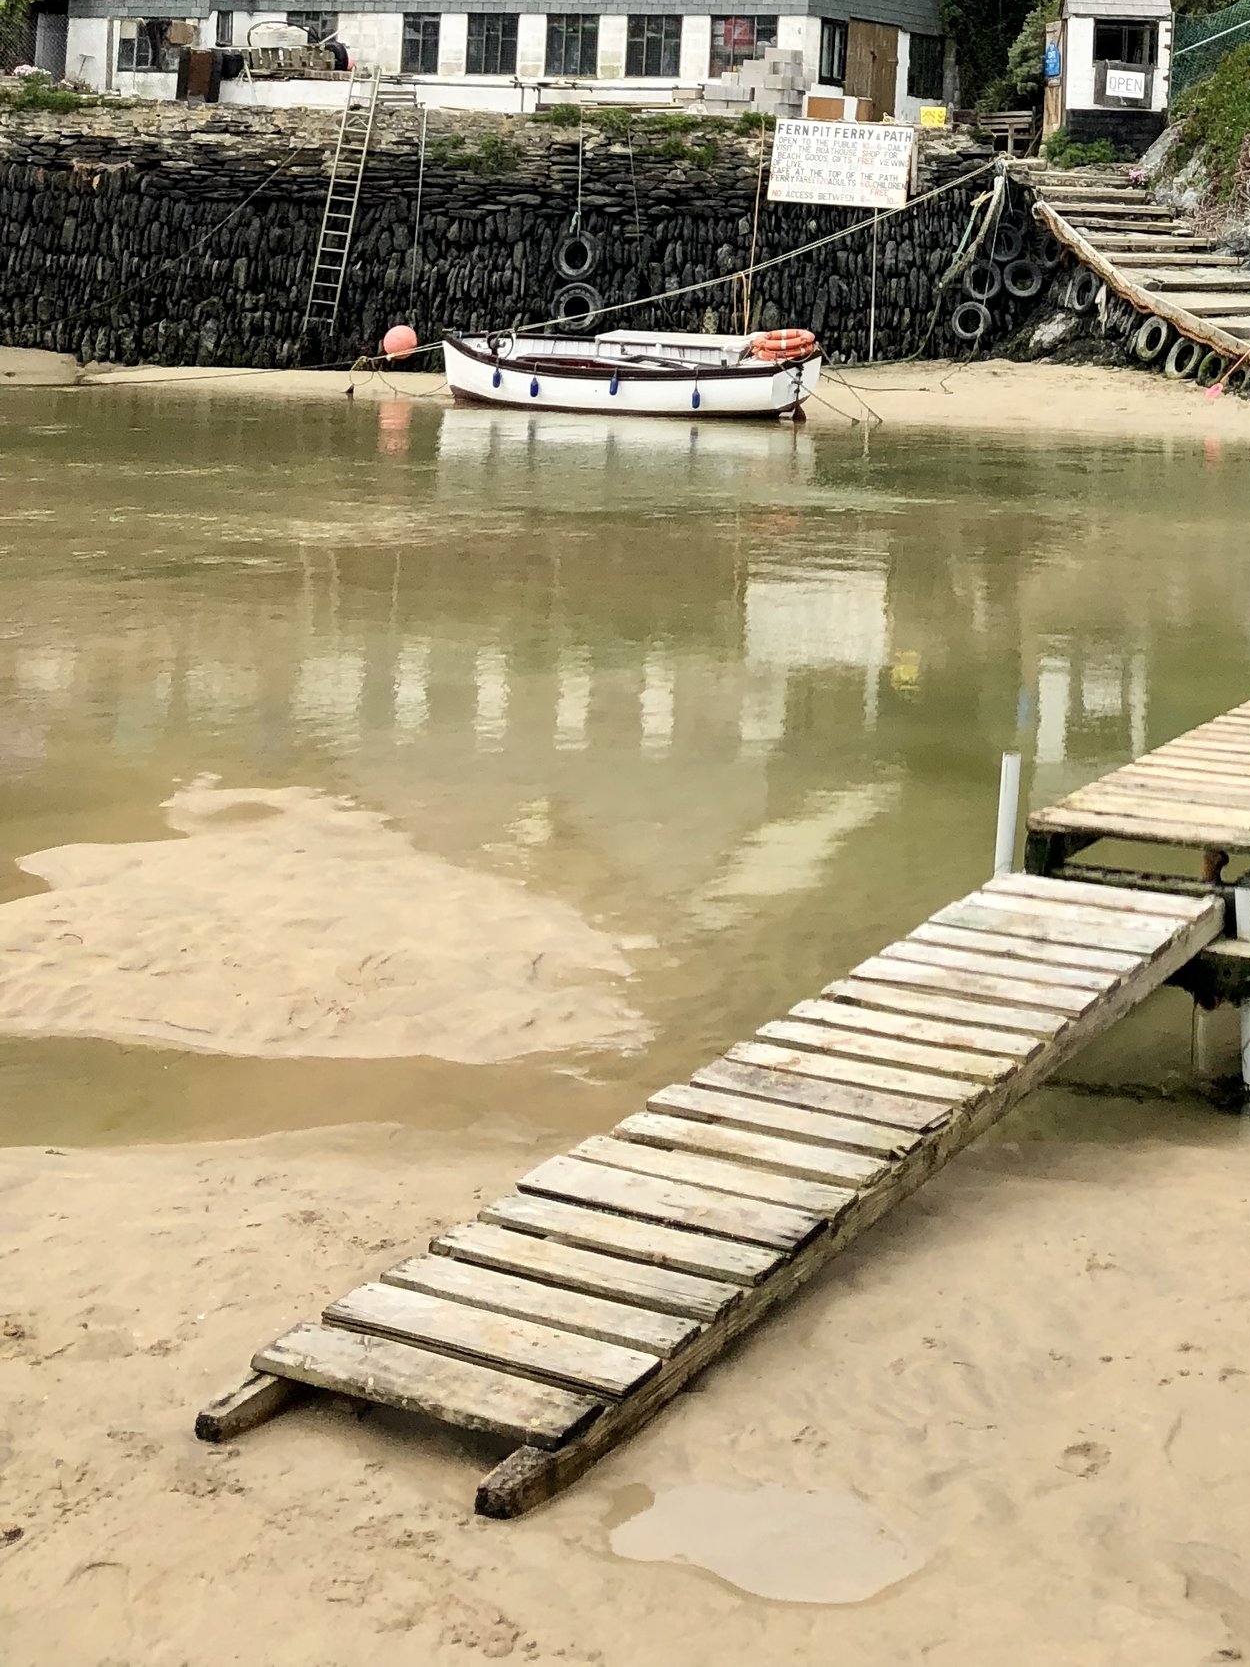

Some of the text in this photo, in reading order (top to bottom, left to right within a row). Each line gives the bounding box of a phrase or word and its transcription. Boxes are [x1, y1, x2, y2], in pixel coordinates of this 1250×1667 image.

[1109, 76, 1142, 92] OPEN
[778, 123, 809, 135] FERN
[812, 126, 831, 137] PIT
[834, 127, 874, 140] FERRY
[883, 130, 912, 142] PATH
[778, 136, 797, 145] OPEN
[802, 138, 811, 146] TO
[816, 138, 829, 147] THE
[833, 140, 858, 149] PUBLIC
[887, 144, 908, 152] DAILY
[798, 145, 812, 153] THE
[815, 146, 858, 156] BOATHOUSE
[862, 150, 880, 158] SHOP
[884, 151, 898, 159] FOR
[773, 158, 782, 166] OF
[777, 151, 801, 160] BEACH
[857, 157, 875, 165] FREE
[879, 159, 909, 168] VIEWING
[810, 169, 823, 177] THE
[828, 170, 842, 178] TOP
[846, 171, 855, 179] OF
[860, 172, 874, 180] THE
[878, 174, 898, 182] PATH
[771, 189, 782, 197] NO
[785, 190, 814, 199] ACCESS
[818, 192, 854, 202] BETWEEN
[870, 189, 889, 197] FREE
